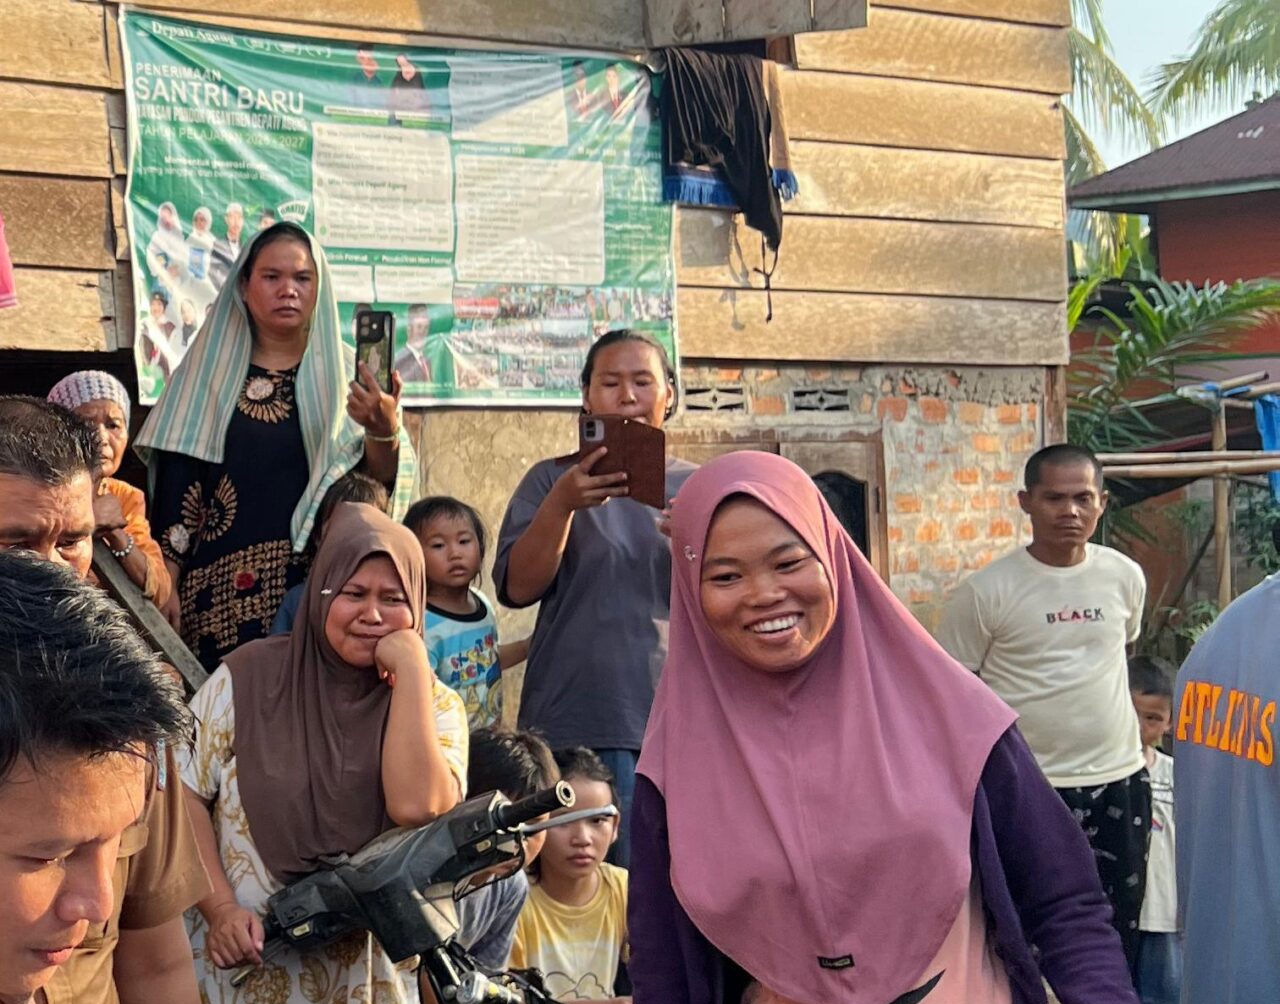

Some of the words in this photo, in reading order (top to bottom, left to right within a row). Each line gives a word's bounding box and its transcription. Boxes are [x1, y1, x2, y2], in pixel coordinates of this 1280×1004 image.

[135, 62, 221, 82] PENERIMAAN
[134, 76, 228, 108] SANTRI
[235, 85, 304, 115] BARU
[1045, 607, 1105, 624] BLACK
